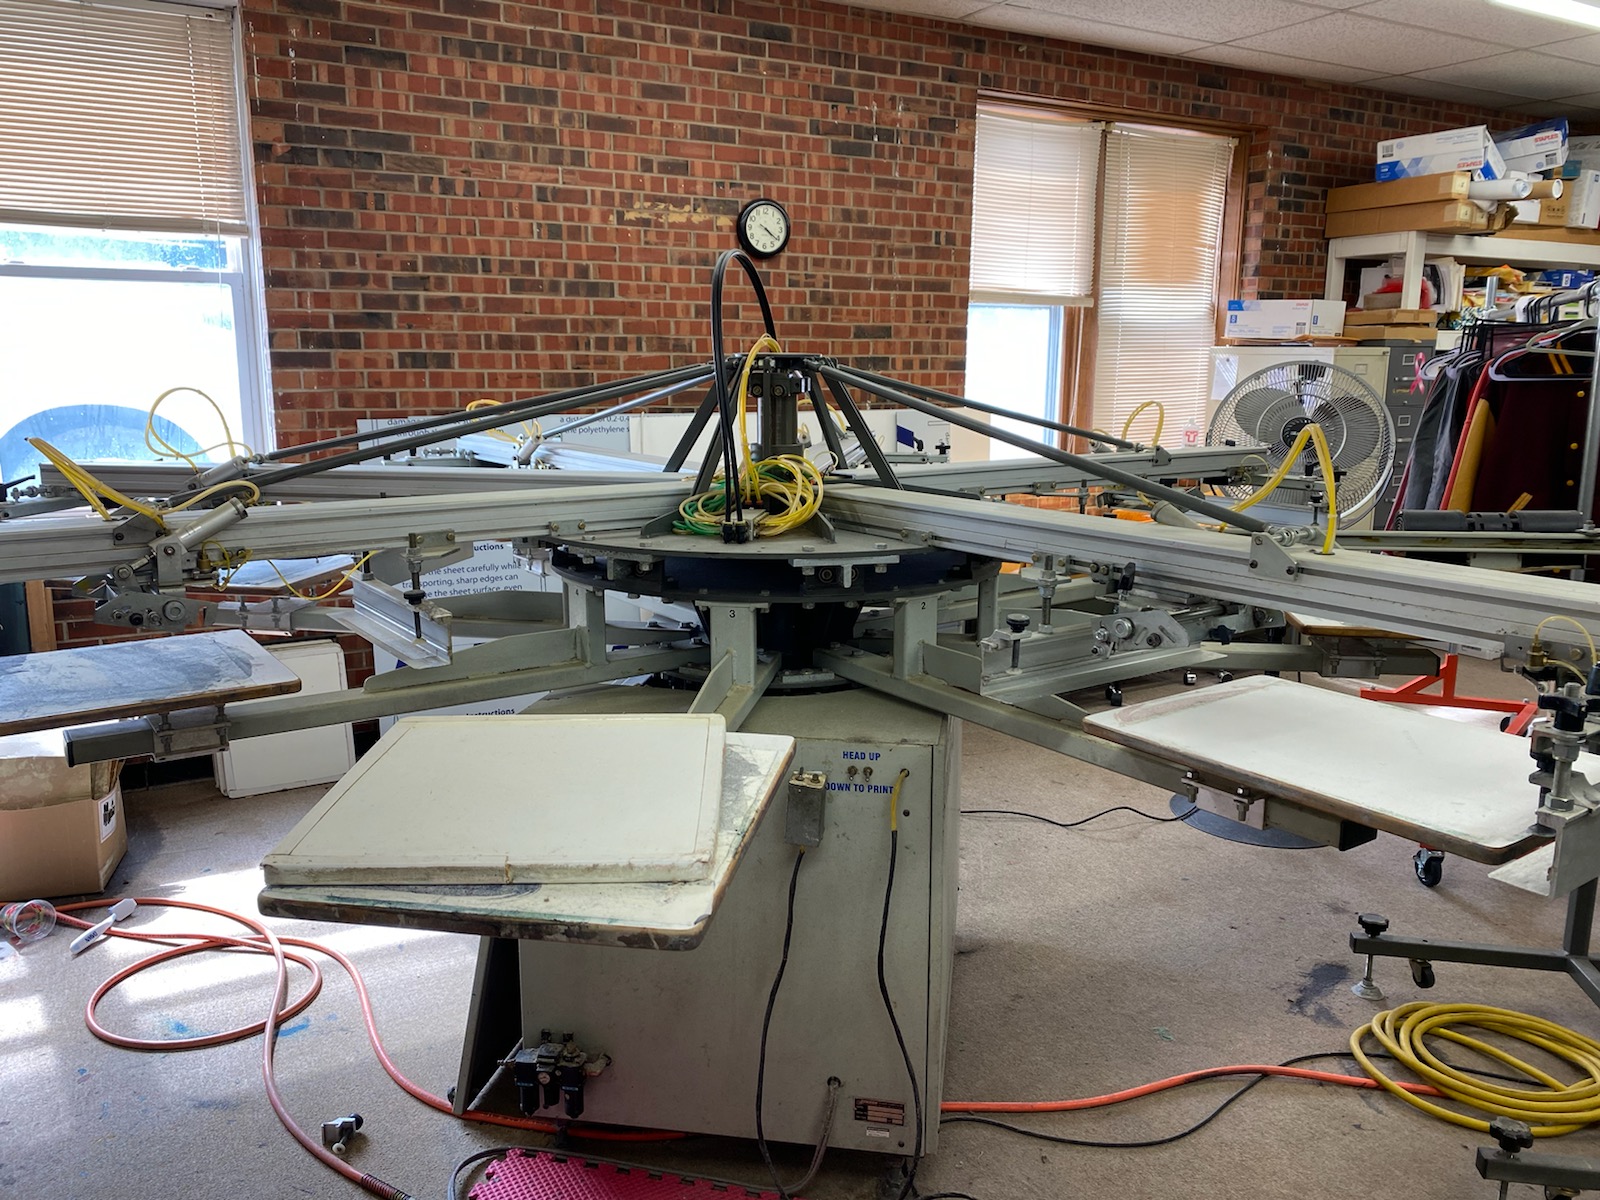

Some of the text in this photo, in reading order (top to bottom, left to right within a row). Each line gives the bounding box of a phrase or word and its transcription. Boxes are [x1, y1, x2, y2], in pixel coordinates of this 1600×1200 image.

[1534, 133, 1559, 143] STAPLES
[579, 425, 625, 435] polyethylene
[474, 543, 504, 551] uctions
[443, 566, 465, 574] sheet
[466, 563, 499, 573] carefully
[402, 578, 455, 589] trasporting,
[456, 576, 478, 585] sharp
[480, 574, 503, 584] edges
[434, 589, 448, 597] the
[920, 601, 926, 610] 2
[729, 609, 736, 618] 3
[842, 751, 881, 761] HEAD UP
[854, 783, 865, 793] TO
[867, 785, 894, 794] PRINT
